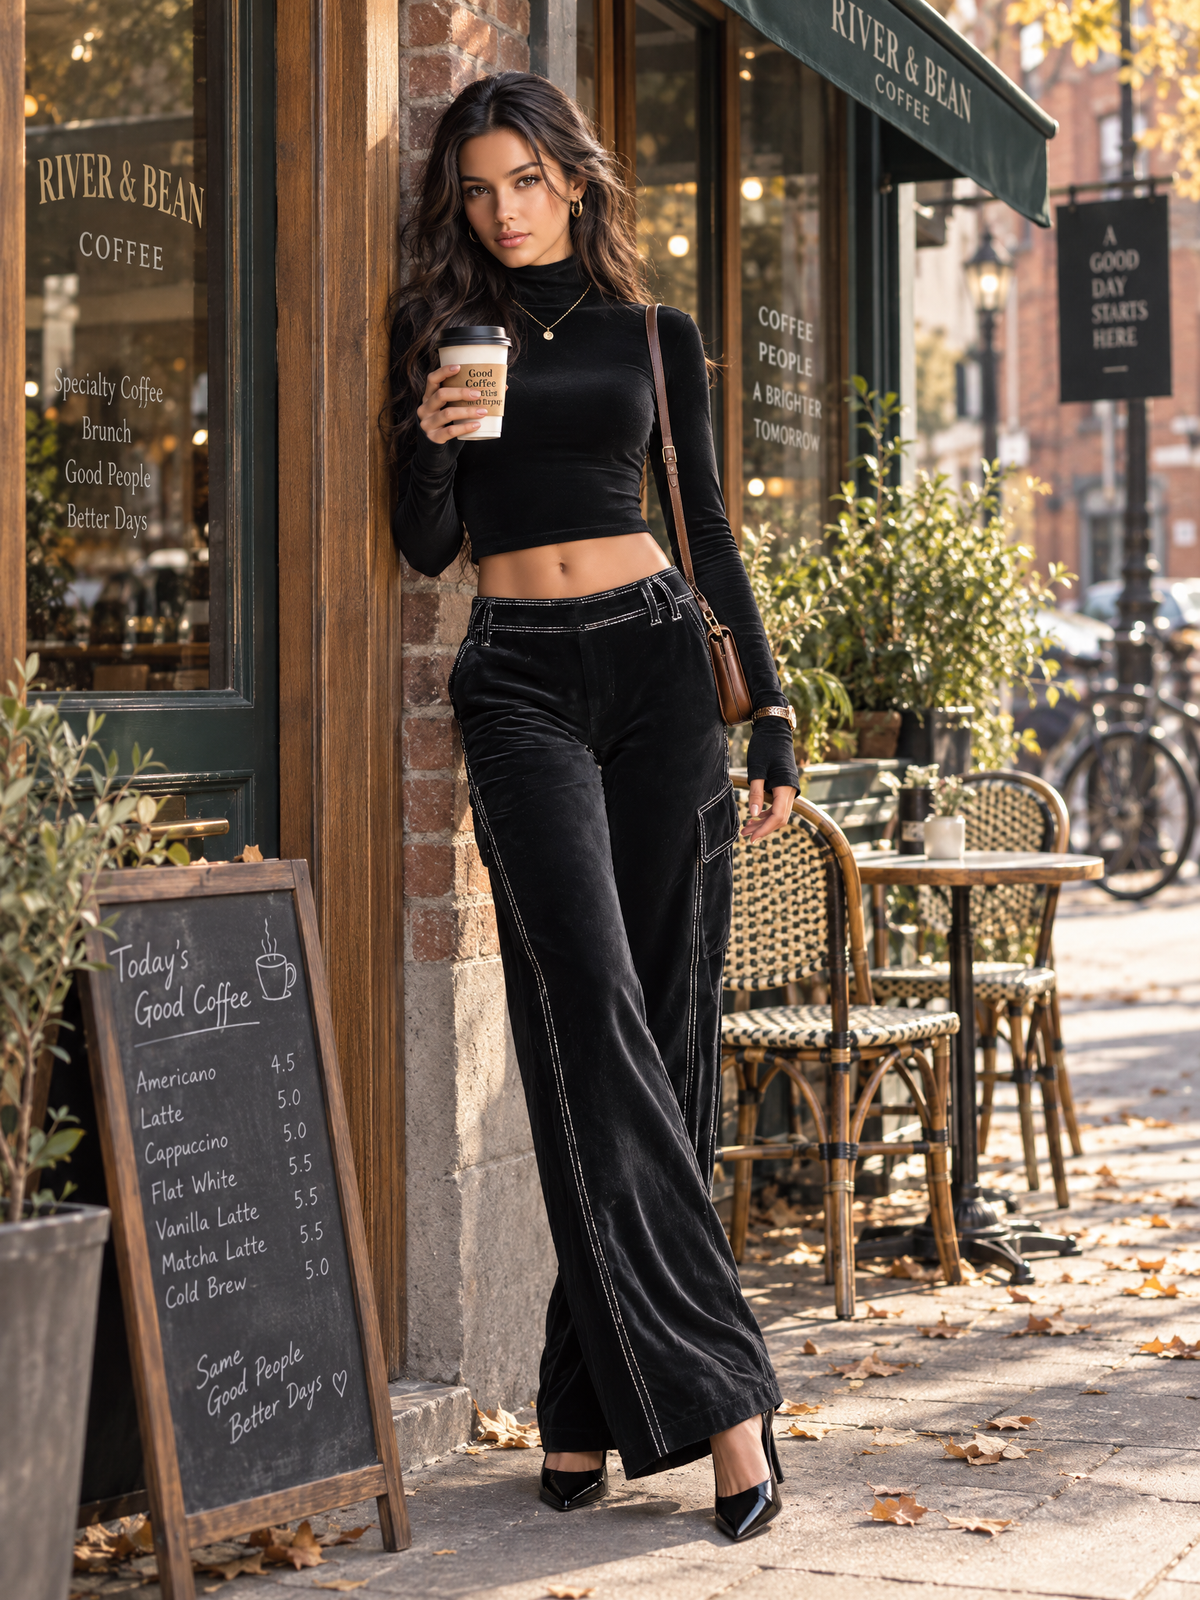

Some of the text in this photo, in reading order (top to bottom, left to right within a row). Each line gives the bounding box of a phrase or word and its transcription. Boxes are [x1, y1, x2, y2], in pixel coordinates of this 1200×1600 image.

[831, 0, 971, 123] RIVER & BEAN
[875, 73, 930, 125] COFFEE
[38, 153, 204, 228] RIVER & BEAN
[79, 231, 163, 270] COFFEE
[1102, 224, 1118, 246] A
[1089, 249, 1140, 274] GOOD
[1092, 275, 1128, 299] DAY
[758, 305, 813, 343] COFFEE
[1091, 299, 1149, 325] STARTS
[1093, 326, 1138, 350] HERE
[469, 369, 492, 377] Good
[759, 341, 812, 377] PEOPLE
[54, 367, 163, 408] Specialty Coffee
[466, 379, 496, 387] Coffee
[753, 381, 822, 419] A BRIGHTER
[82, 416, 132, 443] Brunch
[753, 418, 820, 452] TOMORROW
[65, 459, 151, 495] Good People
[67, 503, 148, 539] Better Days
[109, 939, 189, 990] Today's
[134, 981, 252, 1028] Good Coffee
[136, 1053, 295, 1094] Americano 4.5
[141, 1088, 301, 1129] Latte 5.0
[144, 1122, 307, 1168] Cappuccino 5.0
[151, 1153, 312, 1204] Flat White 5.5
[155, 1187, 318, 1240] Vanilla Latte 5.5
[162, 1221, 323, 1275] Matcha Latte 5.5
[165, 1257, 329, 1309] Cold Brew 5.0
[196, 1350, 244, 1390] Same
[207, 1340, 304, 1416] Good People
[228, 1375, 322, 1444] Better Days
